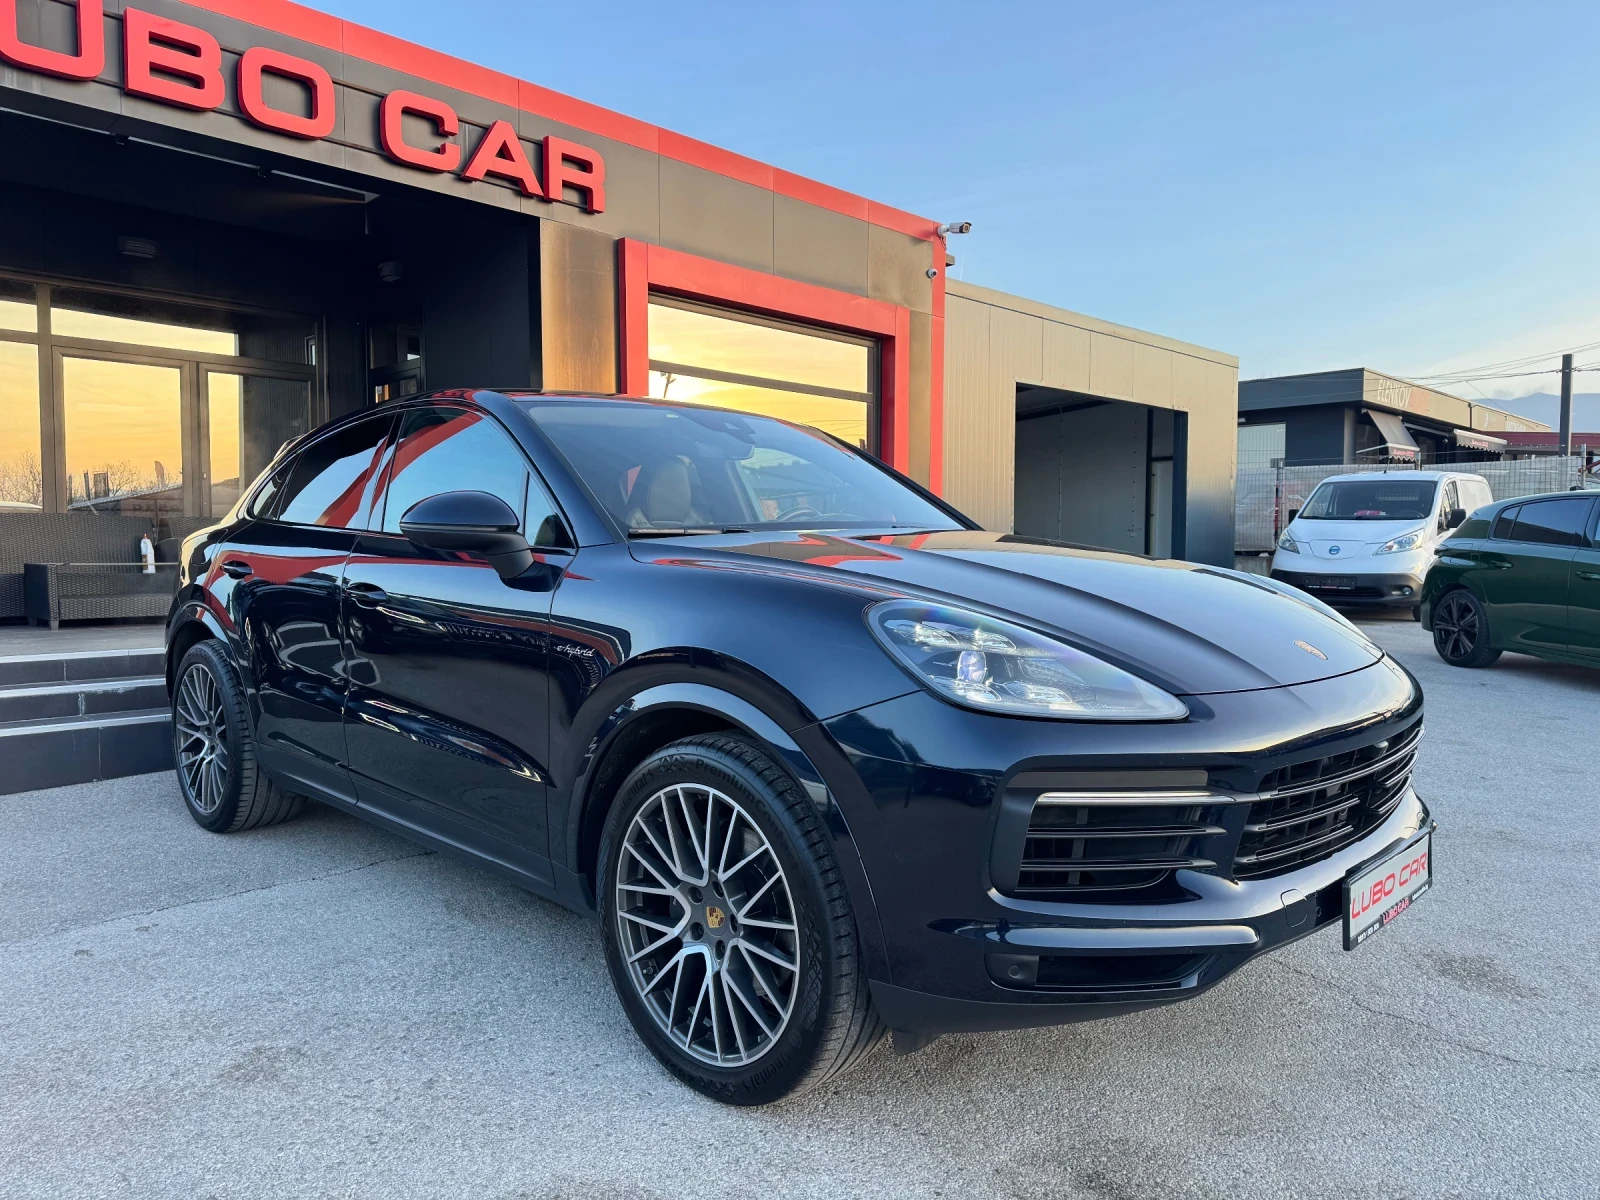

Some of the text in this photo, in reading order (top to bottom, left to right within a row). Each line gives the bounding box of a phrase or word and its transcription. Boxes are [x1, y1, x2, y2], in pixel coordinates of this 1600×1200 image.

[380, 90, 605, 213] CAR
[1352, 873, 1395, 919] LUBO
[1399, 852, 1427, 887] CAR
